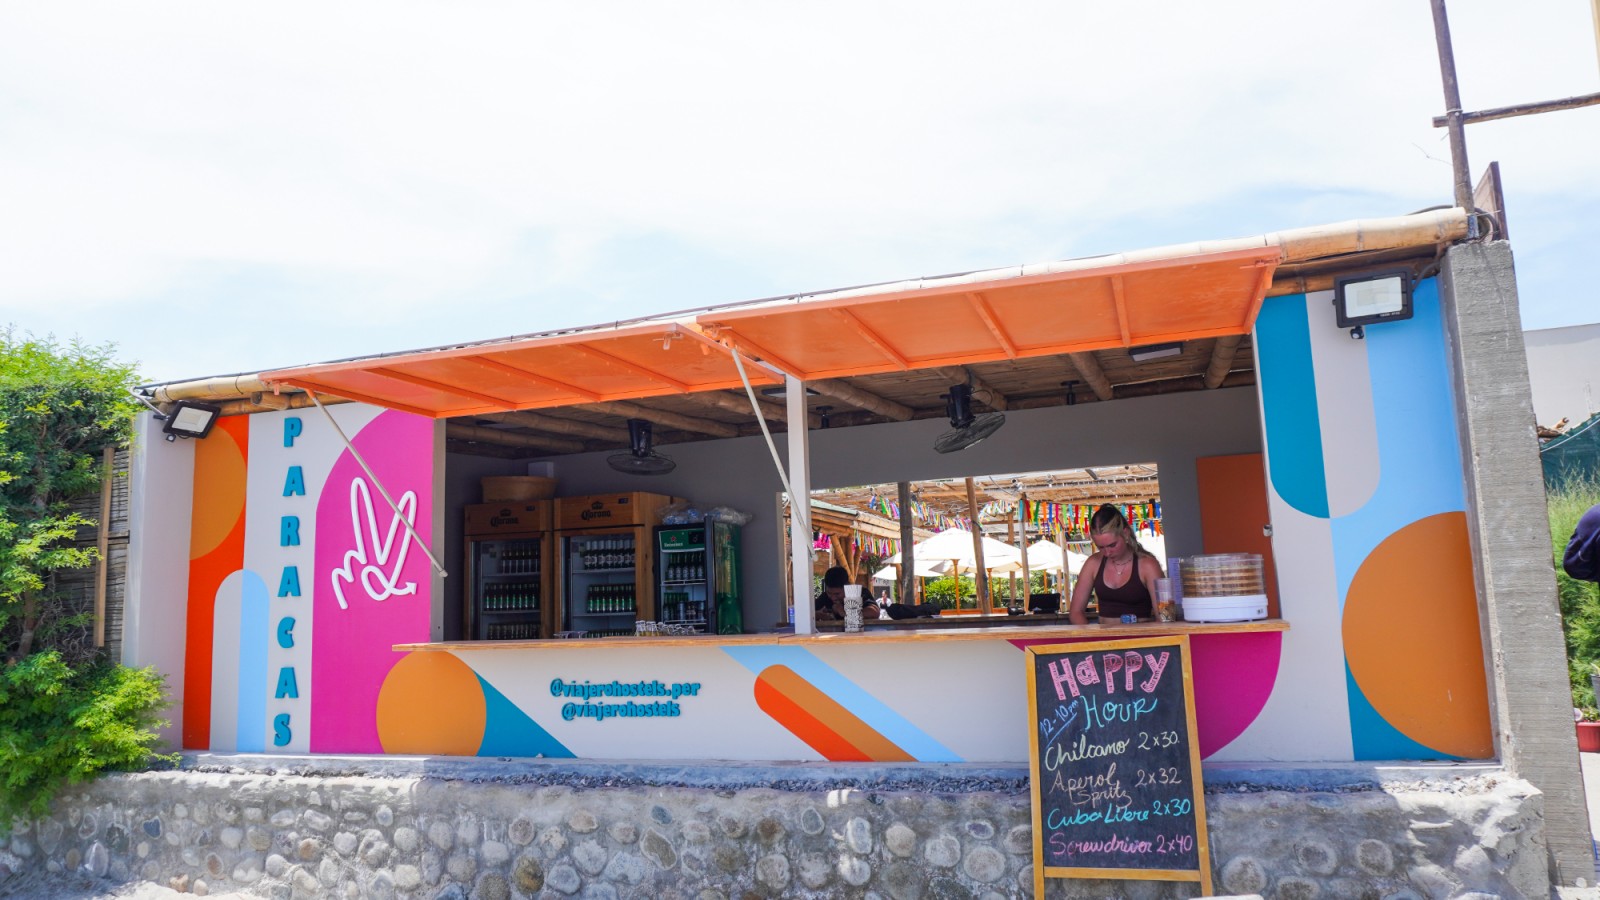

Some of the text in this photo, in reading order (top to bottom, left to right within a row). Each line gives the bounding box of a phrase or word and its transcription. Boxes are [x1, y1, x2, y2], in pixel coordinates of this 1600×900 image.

[273, 417, 306, 747] PARACAS
[550, 678, 701, 700] @viajerohostels.per
[561, 701, 681, 721] @viajerohostels
[1045, 733, 1130, 771] Chilcano
[1048, 762, 1117, 800] Aperol
[1072, 780, 1133, 810] Spritz
[1047, 808, 1102, 830] Cuba
[1103, 797, 1150, 824] Libre
